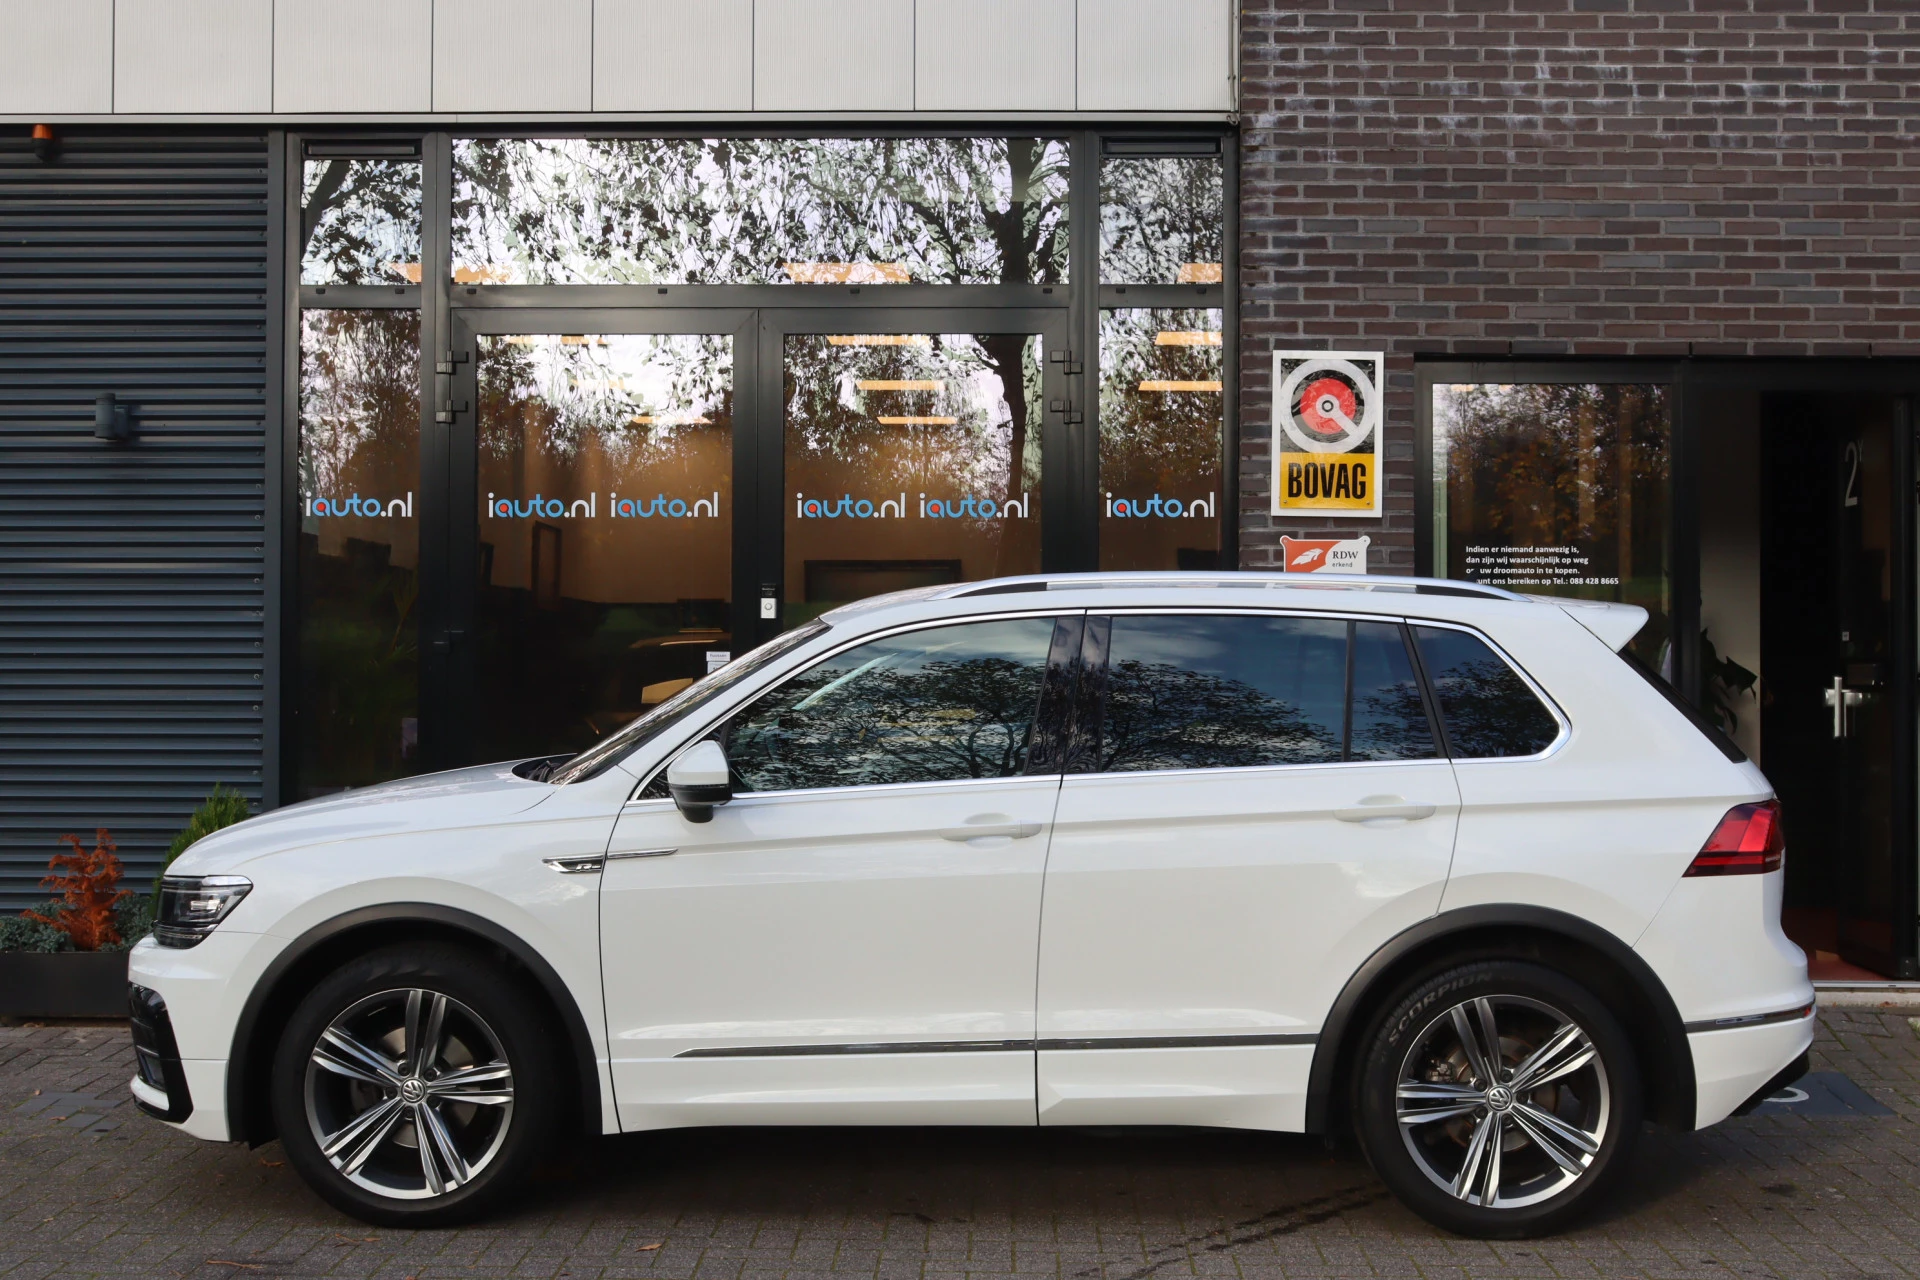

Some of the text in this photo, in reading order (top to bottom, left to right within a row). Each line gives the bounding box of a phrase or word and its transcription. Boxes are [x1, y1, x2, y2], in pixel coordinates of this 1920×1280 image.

[1287, 462, 1367, 500] BOVAG
[305, 491, 413, 518] iauto.nl
[487, 492, 719, 518] iauto.nl iauto.nl
[796, 492, 1029, 519] iauto.nl iauto.nl
[1105, 491, 1215, 518] iauto.nl
[1332, 550, 1359, 560] RDW
[1466, 545, 1489, 553] Indien
[1500, 545, 1533, 553] niemand
[1535, 545, 1570, 554] aanwezig
[1571, 545, 1580, 554] is,
[1481, 556, 1495, 565] zijn
[1496, 556, 1508, 565] wij
[1509, 556, 1560, 565] waarschijnlijk
[1561, 557, 1571, 565] op
[1573, 557, 1589, 565] weg
[1493, 566, 1535, 574] droomauto
[1536, 566, 1544, 574] in
[1554, 566, 1580, 575] kopen.
[1507, 577, 1540, 585] bereiken
[1541, 578, 1552, 586] op
[1553, 577, 1569, 585] Tel.:
[1570, 577, 1584, 585] 088
[1585, 577, 1599, 585] 428
[1600, 577, 1619, 585] 8665
[1389, 971, 1493, 1047] SCORPION
